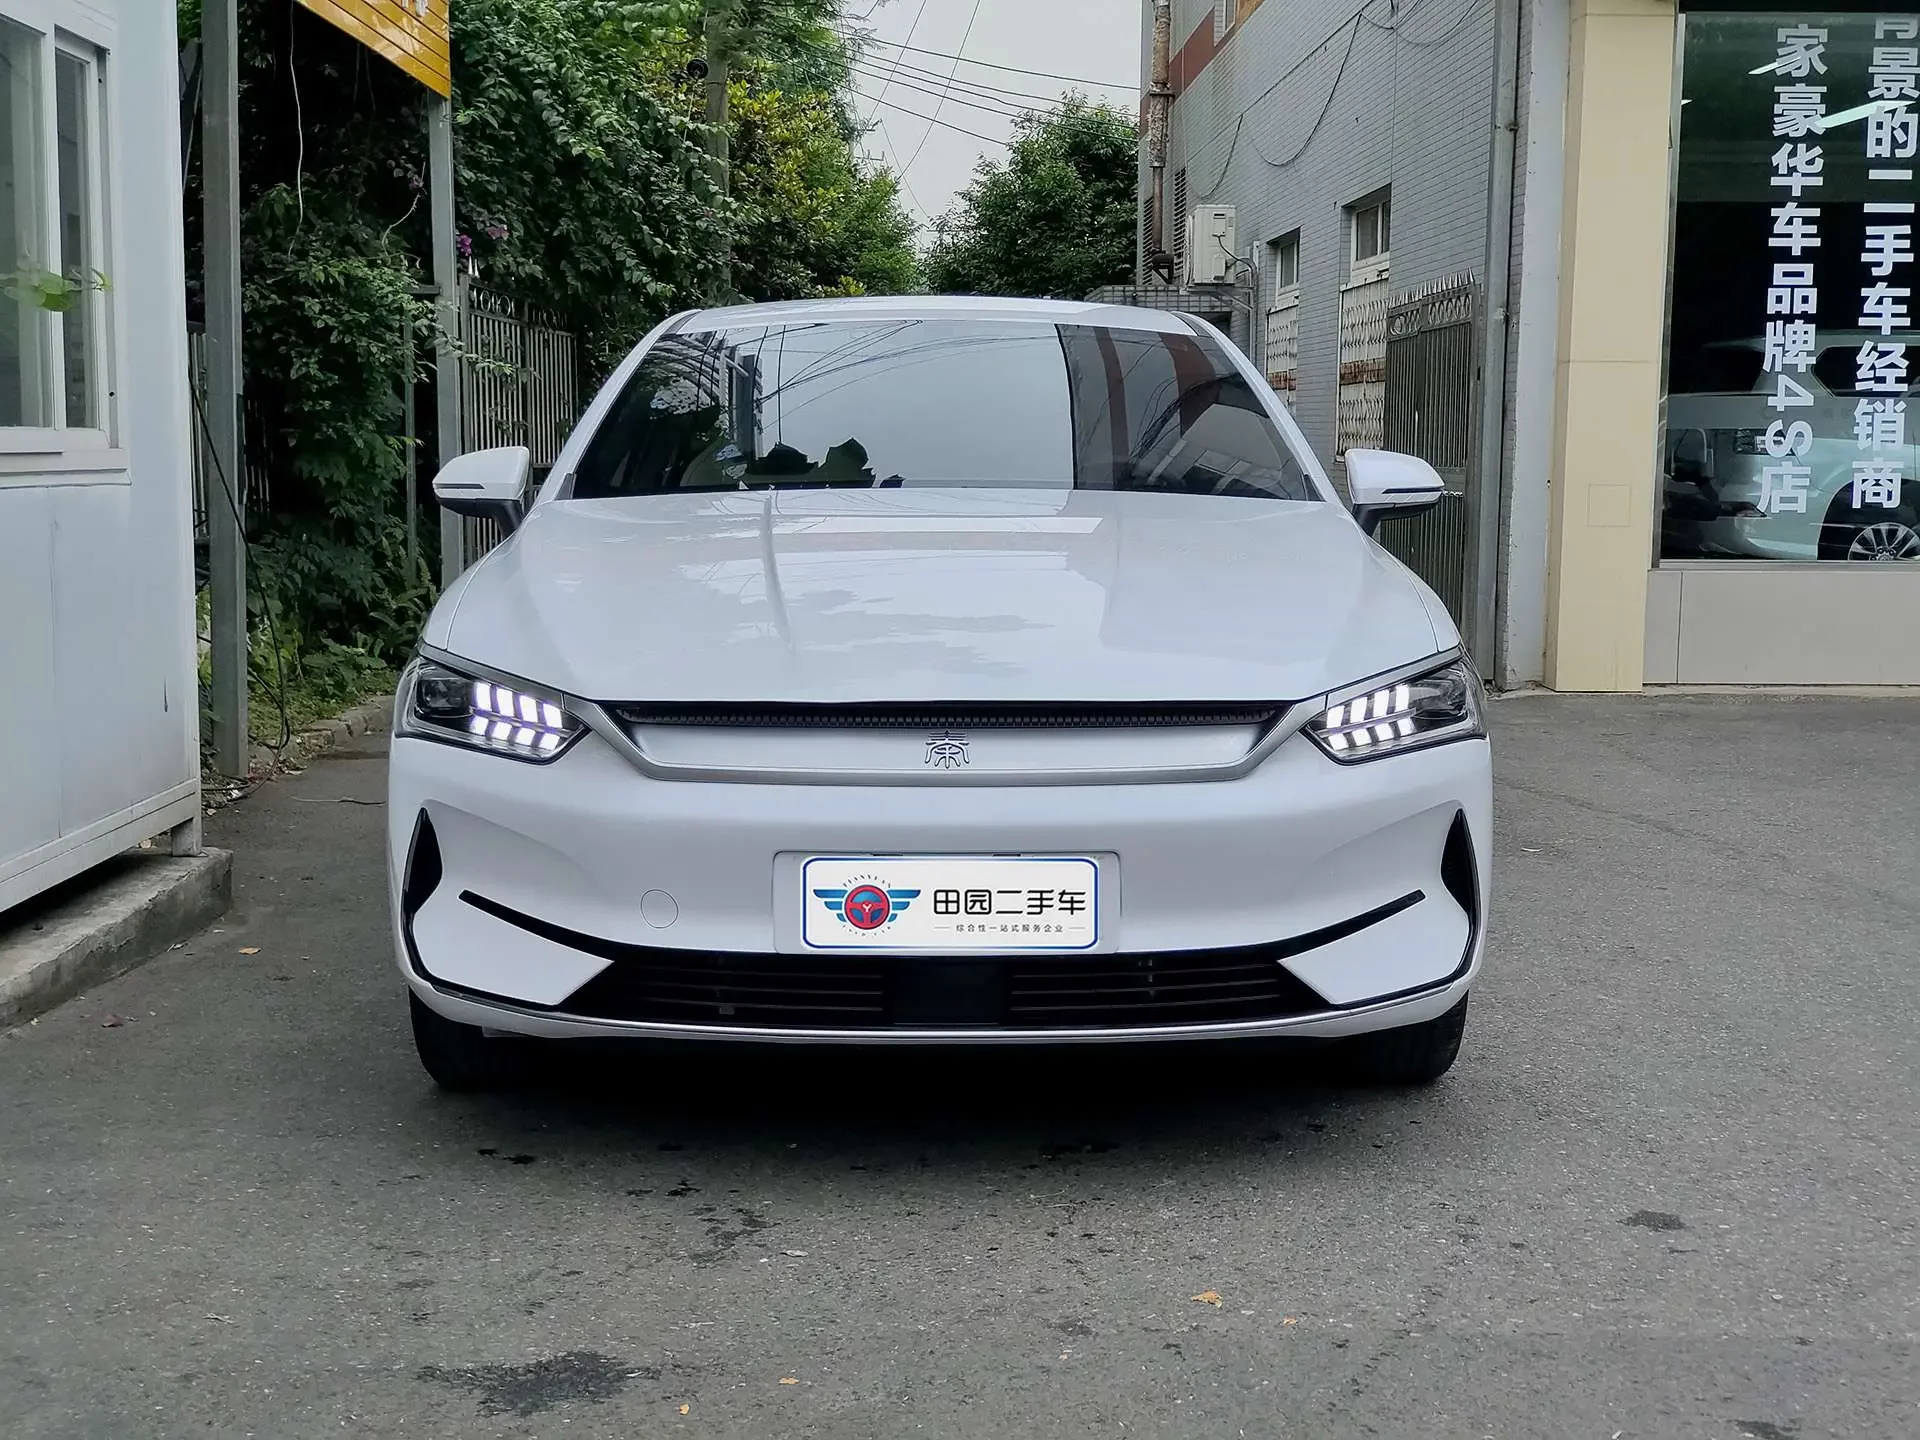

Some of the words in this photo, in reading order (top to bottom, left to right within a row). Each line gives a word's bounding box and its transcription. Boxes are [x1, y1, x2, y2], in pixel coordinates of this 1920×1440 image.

[1756, 23, 1829, 514] 家豪华车品牌4S店
[933, 888, 1087, 916] 田园二手车
[956, 923, 1064, 933] 综合性一站式服务企业
